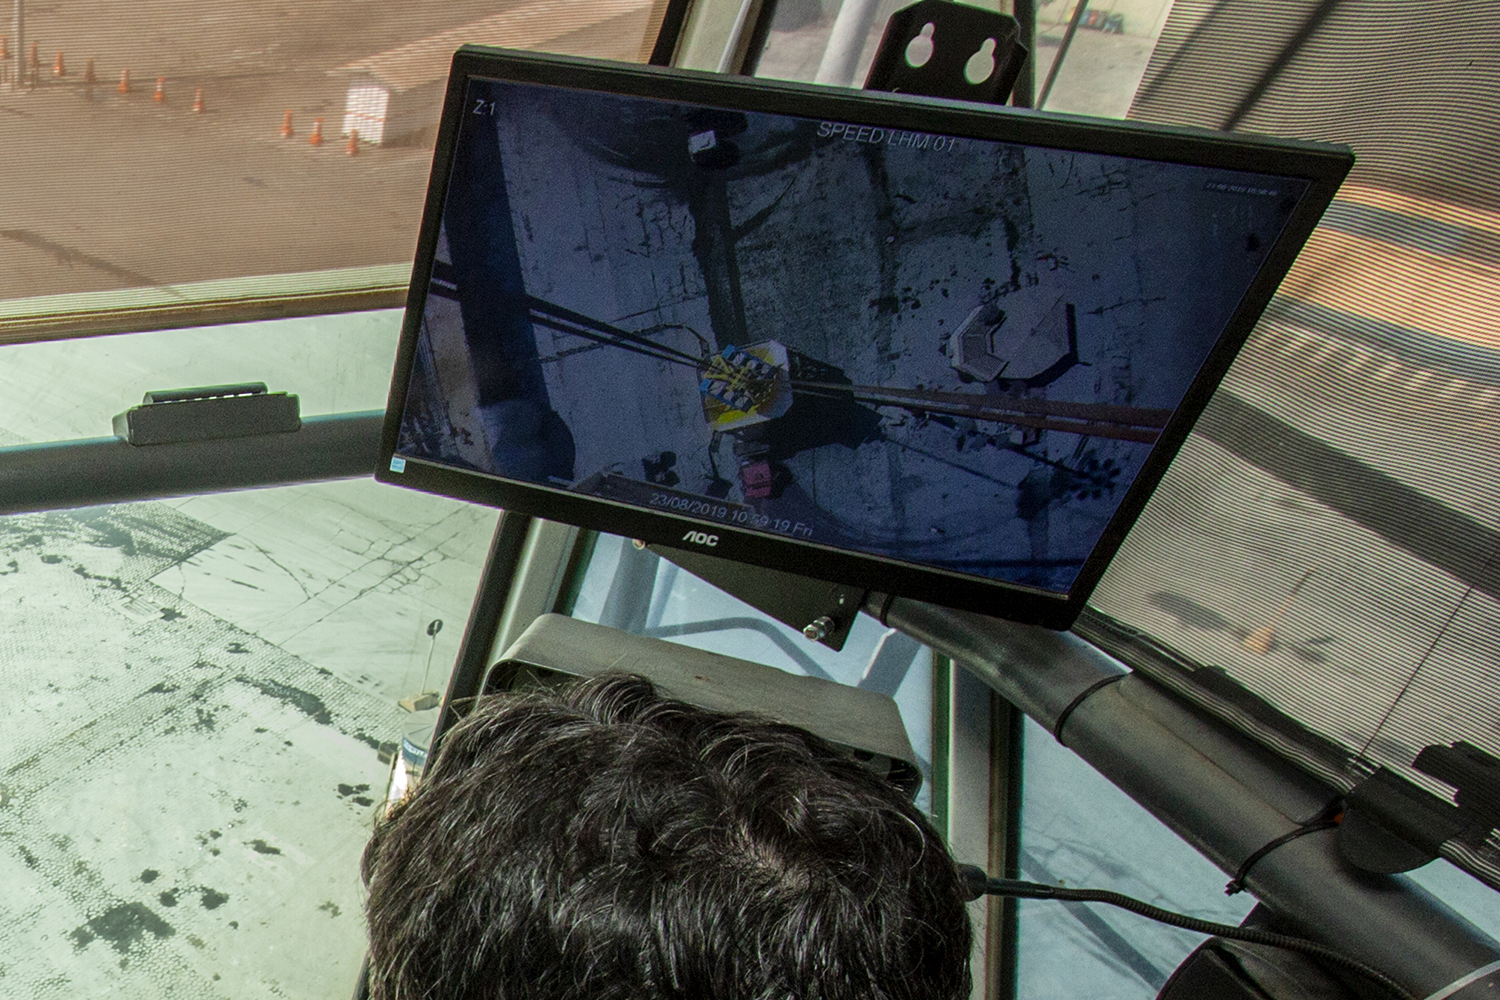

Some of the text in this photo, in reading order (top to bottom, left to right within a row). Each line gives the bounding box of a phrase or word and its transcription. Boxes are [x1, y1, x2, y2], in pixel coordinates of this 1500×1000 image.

[472, 98, 496, 116] Z:1
[816, 121, 957, 153] SPEED LHM 01
[650, 493, 727, 518] 23/08/2019
[792, 522, 814, 538] Fri
[682, 530, 720, 547] AOC
